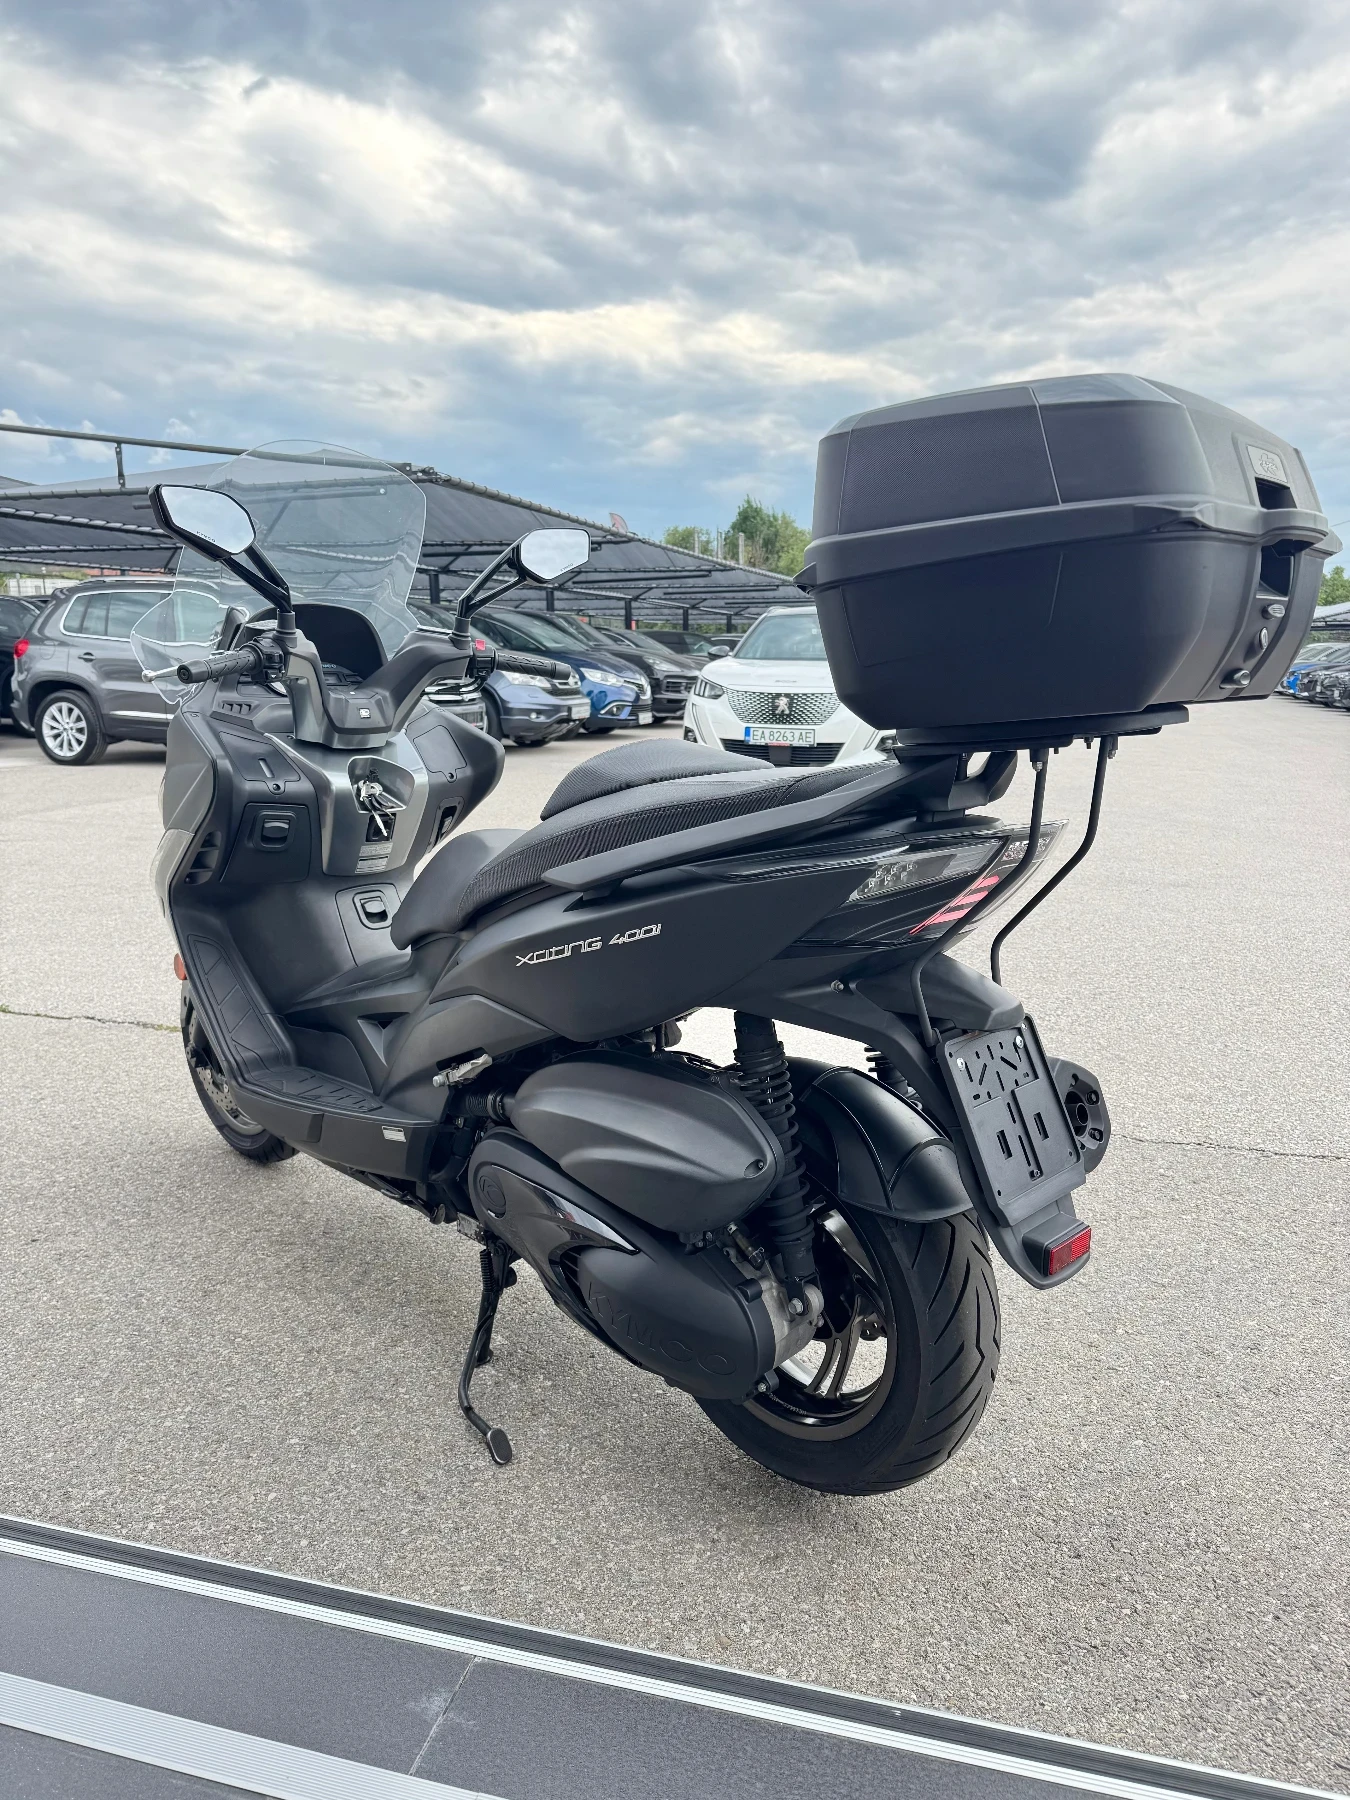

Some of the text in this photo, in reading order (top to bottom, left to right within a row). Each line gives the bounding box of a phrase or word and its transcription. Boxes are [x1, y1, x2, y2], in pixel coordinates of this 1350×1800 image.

[752, 729, 812, 743] EA 8263 AE
[515, 937, 602, 967] XCITING
[587, 1281, 738, 1376] KYMCO
